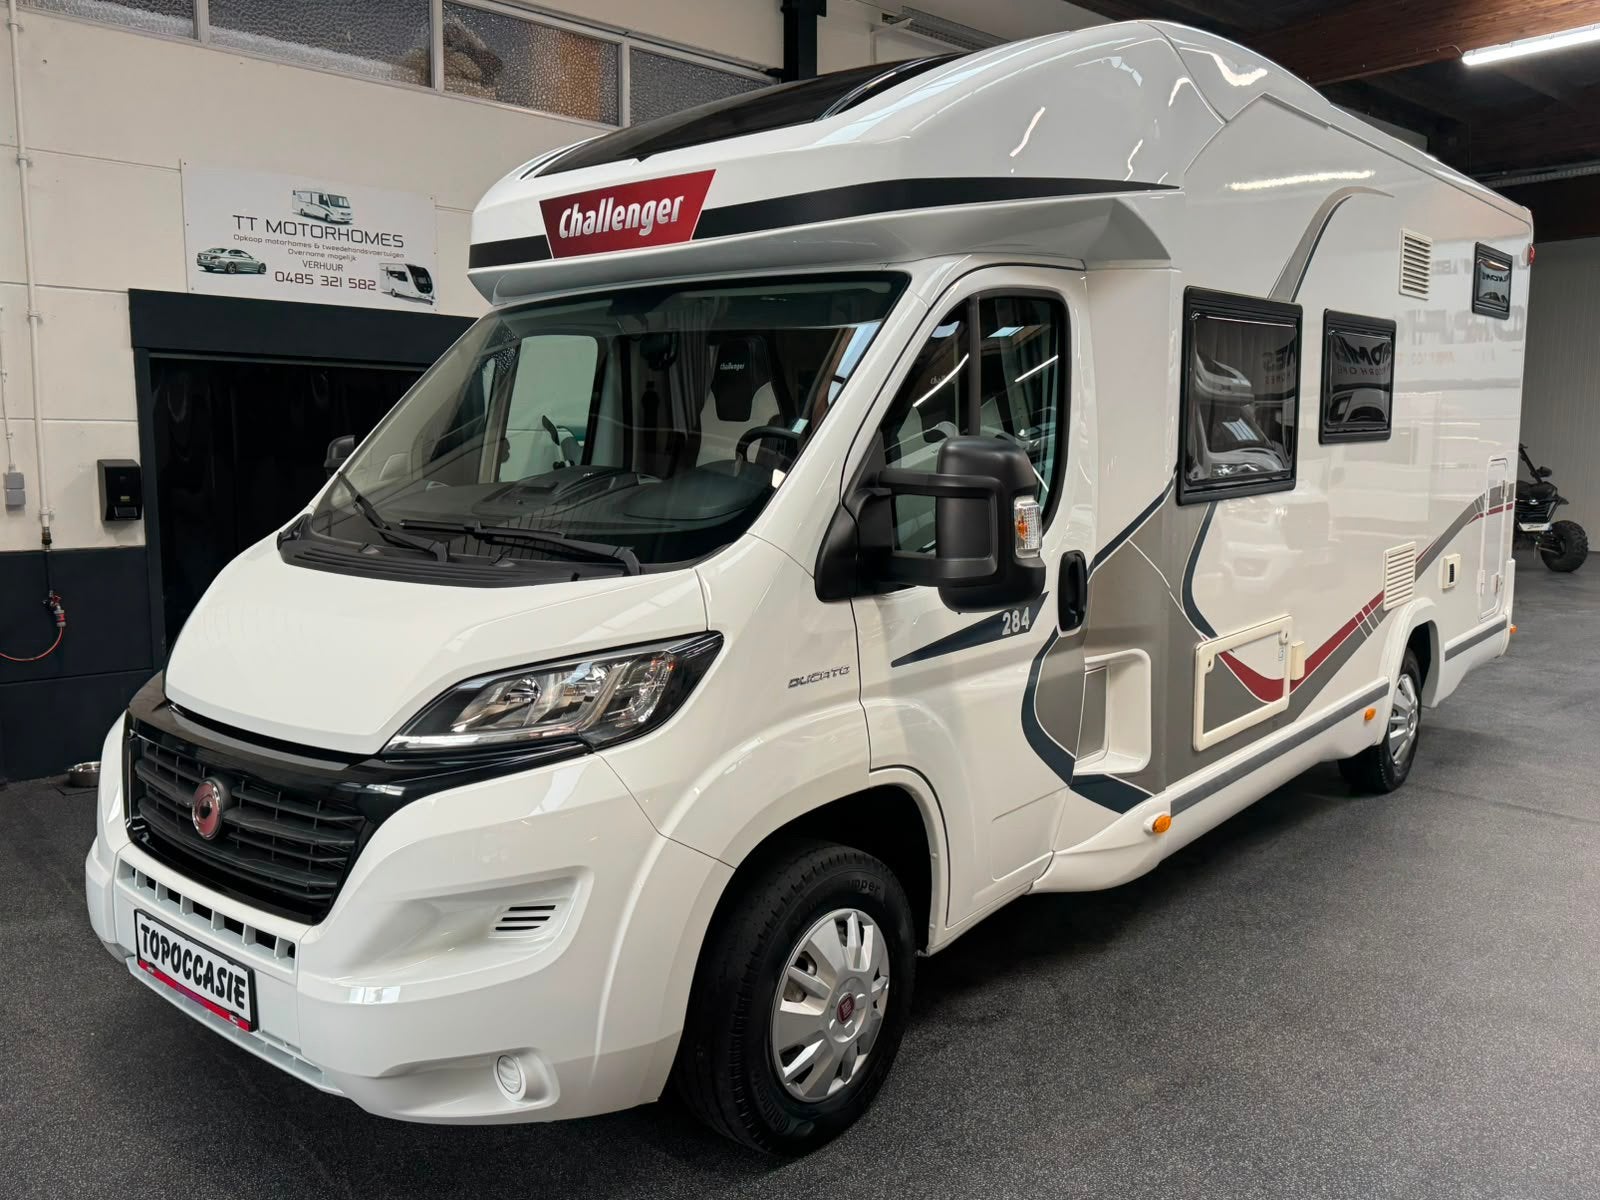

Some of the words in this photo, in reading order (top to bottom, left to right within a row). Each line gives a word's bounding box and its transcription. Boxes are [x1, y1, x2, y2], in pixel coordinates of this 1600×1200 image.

[559, 196, 685, 239] Challenger
[233, 214, 258, 231] TT
[265, 219, 404, 249] MOTORHOMES
[233, 234, 263, 244] Opkoop
[265, 238, 312, 249] motorhomes
[288, 248, 325, 259] Overname
[327, 252, 357, 262] mogelijk
[302, 260, 344, 272] VERHUUR
[275, 270, 314, 286] 0485
[320, 275, 343, 288] 321
[348, 277, 377, 291] 582
[1001, 606, 1030, 636] 284
[788, 665, 850, 689] DUCATO
[140, 923, 246, 1010] TOPOCCASIE
